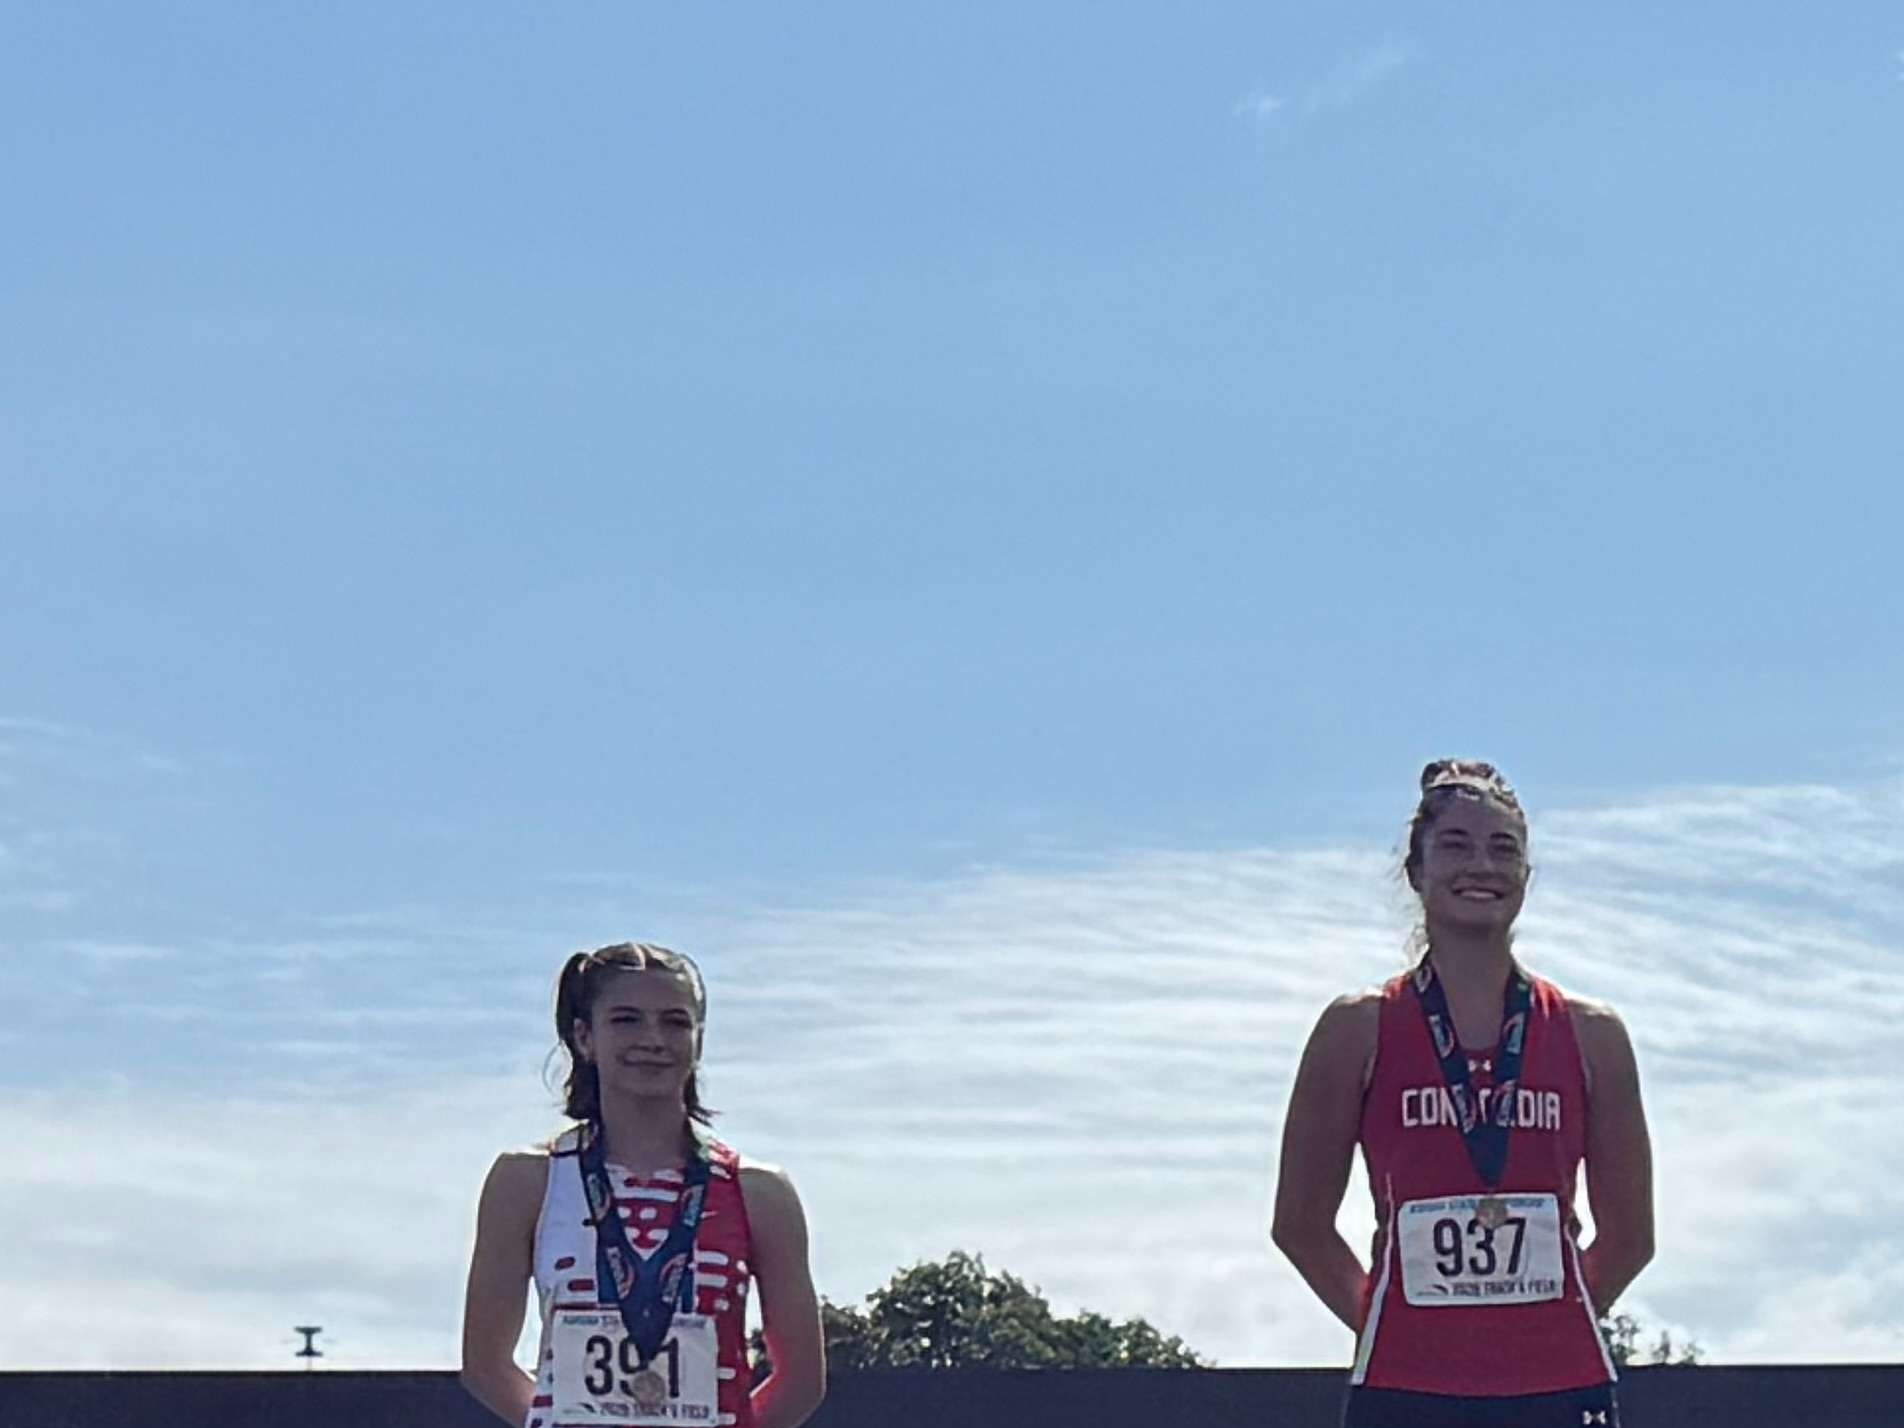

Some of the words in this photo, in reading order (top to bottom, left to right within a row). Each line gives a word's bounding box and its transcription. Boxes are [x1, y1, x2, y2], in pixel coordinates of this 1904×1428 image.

[1402, 1086, 1560, 1131] CONDIA
[1433, 1217, 1526, 1277] 937
[585, 1334, 680, 1399] 391
